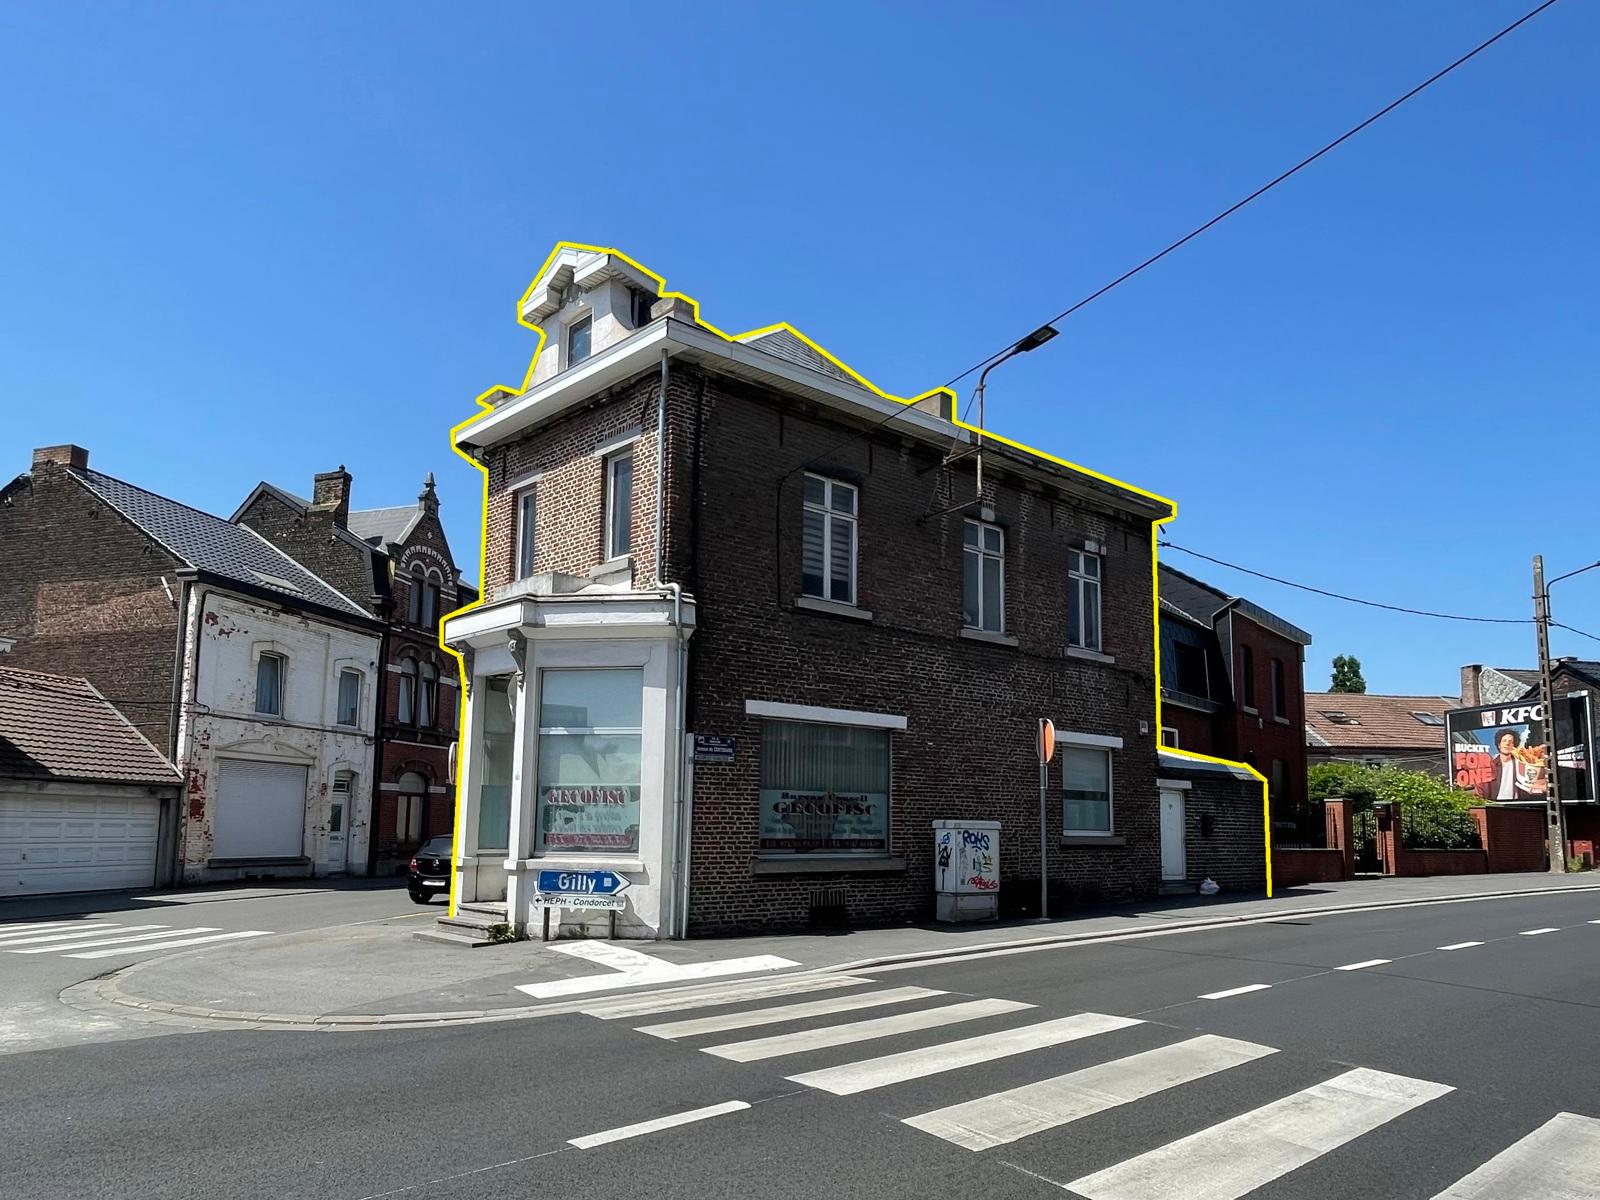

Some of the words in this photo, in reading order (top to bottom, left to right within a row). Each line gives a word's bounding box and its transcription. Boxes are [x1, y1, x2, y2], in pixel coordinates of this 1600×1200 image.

[1500, 705, 1545, 724] KFC
[1454, 743, 1490, 753] BUCKET
[1455, 753, 1492, 770] FOR
[1456, 768, 1494, 787] ONE
[772, 800, 877, 816] GECOFISC
[558, 873, 596, 894] Gilly
[543, 896, 567, 905] HEPH
[573, 898, 615, 908] Condorcet
